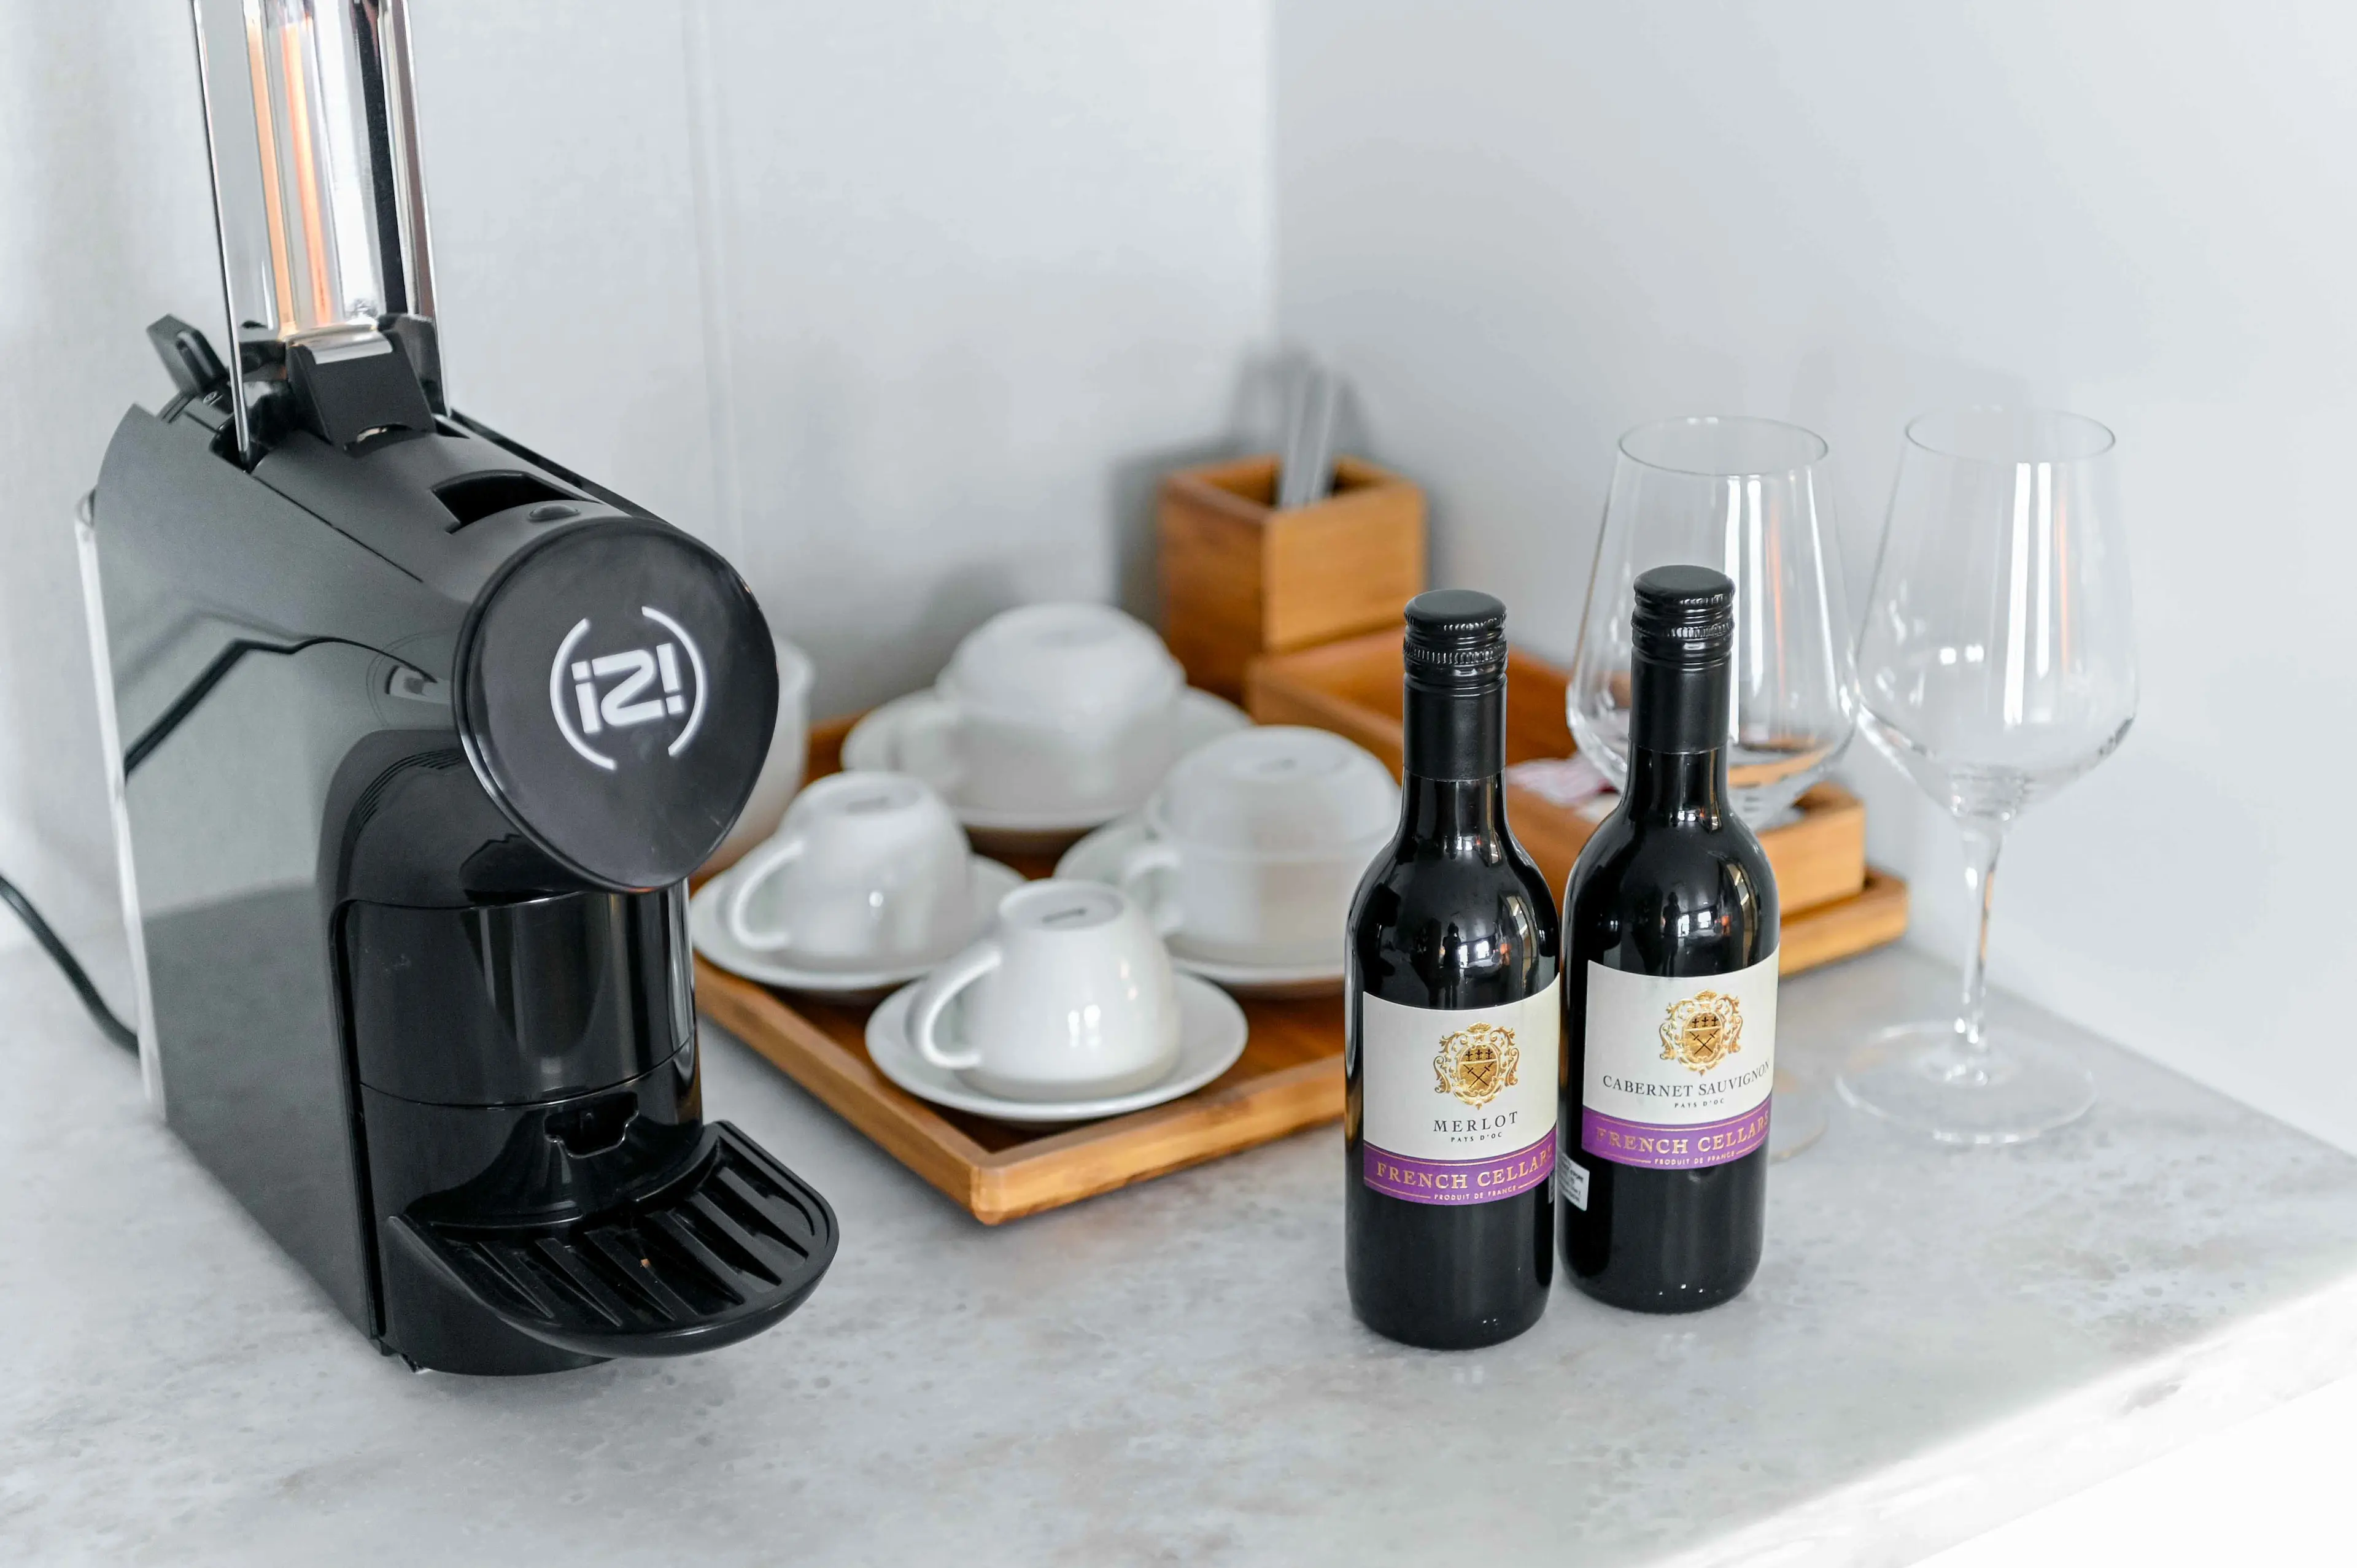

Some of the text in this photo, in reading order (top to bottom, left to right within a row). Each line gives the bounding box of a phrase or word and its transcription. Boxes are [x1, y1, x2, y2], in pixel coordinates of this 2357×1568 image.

[1603, 1059, 1770, 1097] CABERNET SAUVIGNON
[1703, 1098, 1724, 1107] D'OC
[1433, 1111, 1519, 1133] MERLOT
[1480, 1132, 1503, 1141] D'OC
[1596, 1110, 1770, 1154] FRENCH CELLARS
[1654, 1157, 1690, 1166] PRODUIT
[1707, 1150, 1735, 1164] FRANCE
[1376, 1161, 1468, 1189] FRENCH
[1434, 1192, 1471, 1202] PRODUIT
[1488, 1185, 1517, 1198] FRANCE
